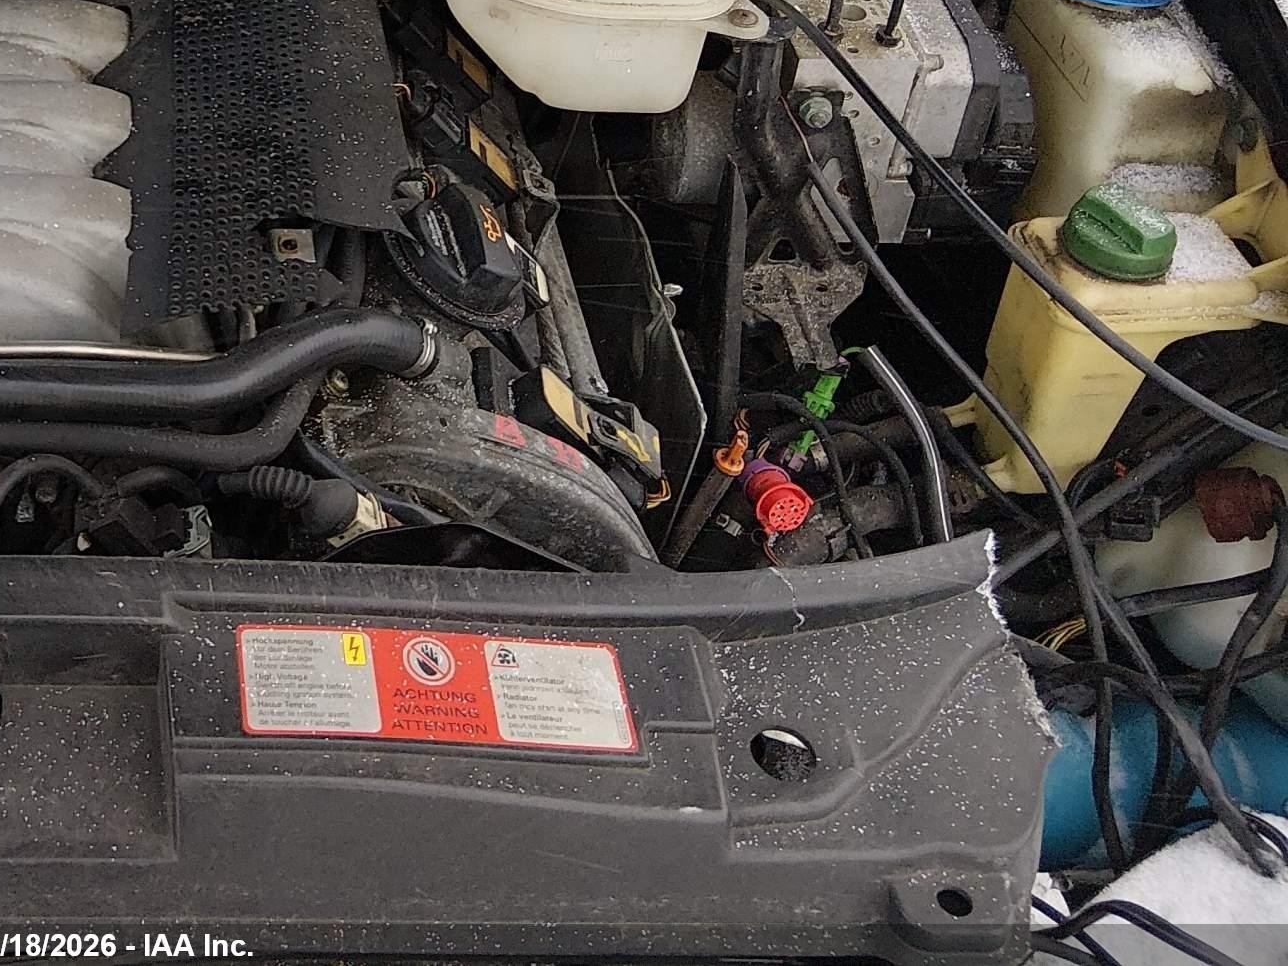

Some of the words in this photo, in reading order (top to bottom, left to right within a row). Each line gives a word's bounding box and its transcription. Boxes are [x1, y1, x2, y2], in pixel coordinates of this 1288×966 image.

[393, 688, 476, 703] ACHTUNG
[503, 692, 537, 701] Radiator
[393, 704, 479, 718] WARNING
[392, 719, 488, 734] ATTENTION
